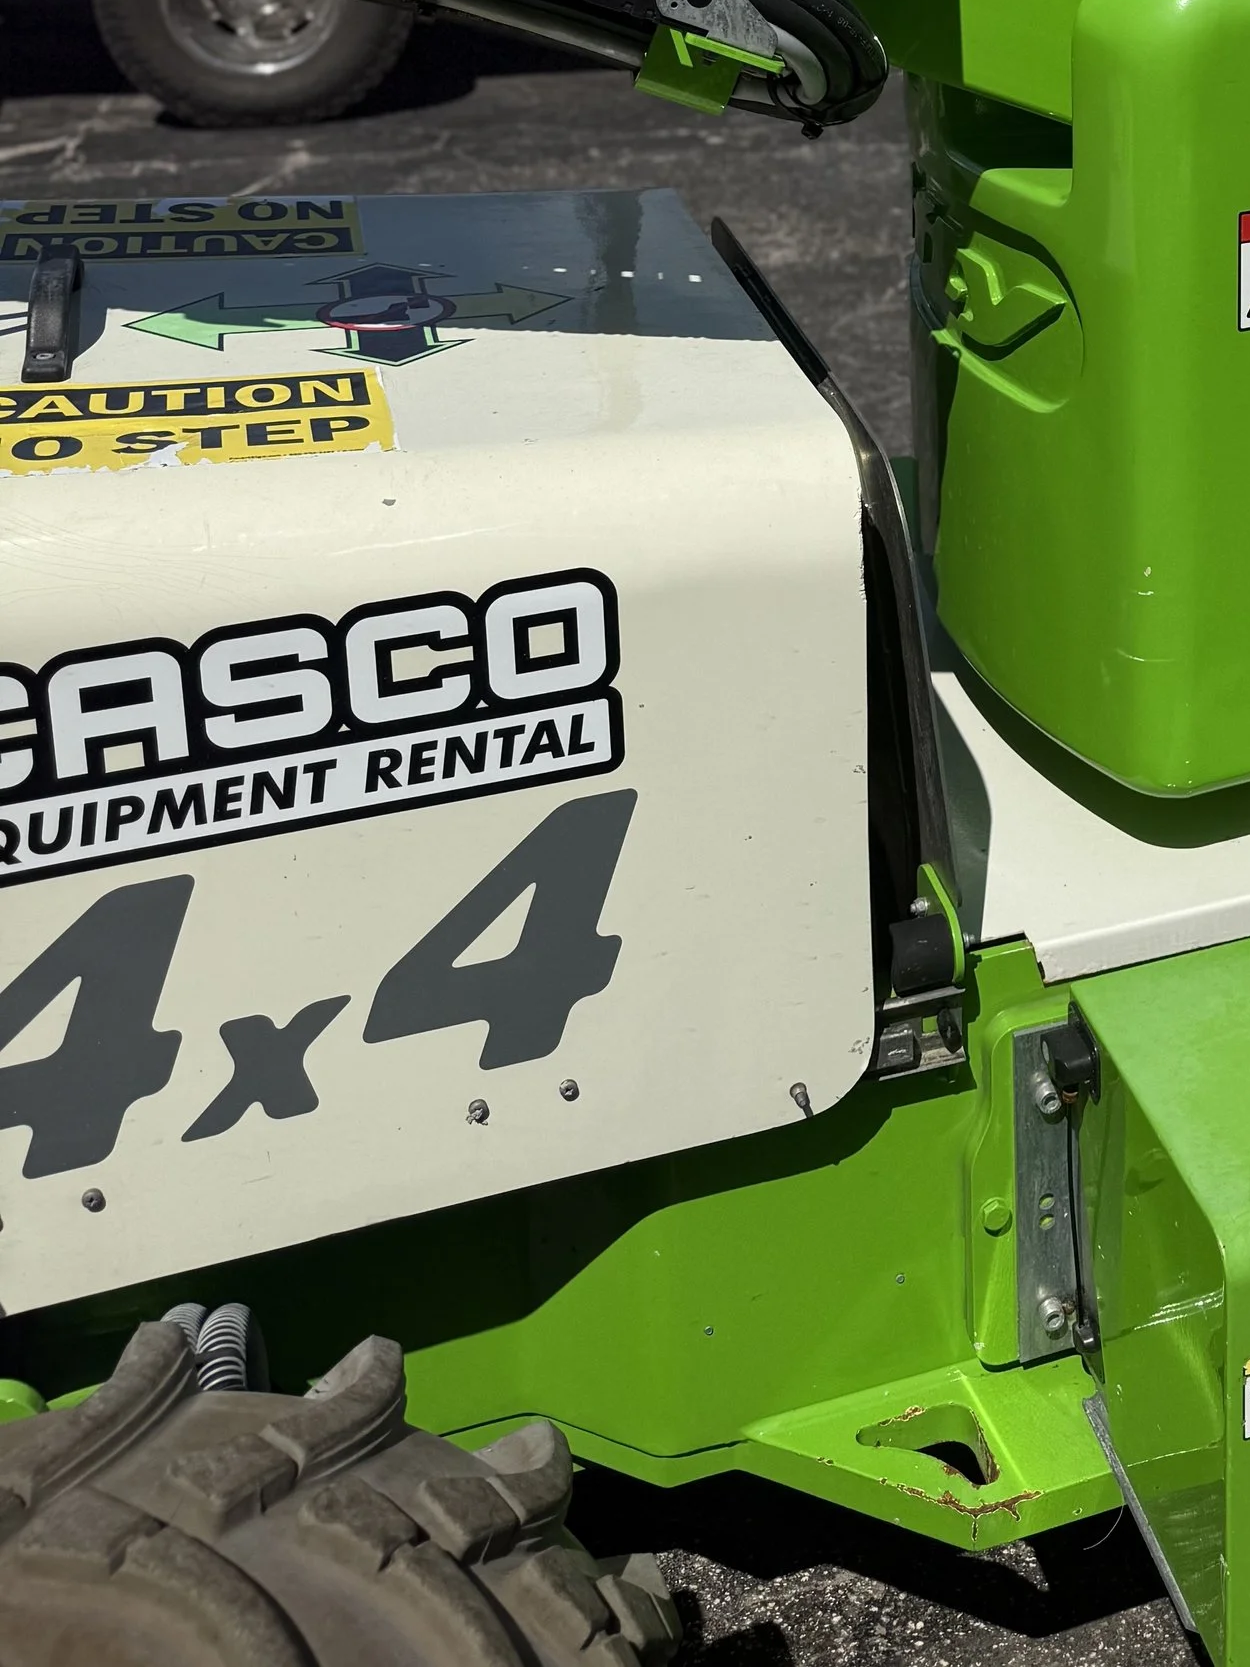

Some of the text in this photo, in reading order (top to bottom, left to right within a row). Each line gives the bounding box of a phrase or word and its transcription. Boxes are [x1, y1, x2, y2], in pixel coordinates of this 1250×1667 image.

[15, 200, 344, 224] NO STEP
[111, 415, 370, 454] STEP
[0, 581, 608, 789] ASCO
[363, 713, 597, 792] RENTAL
